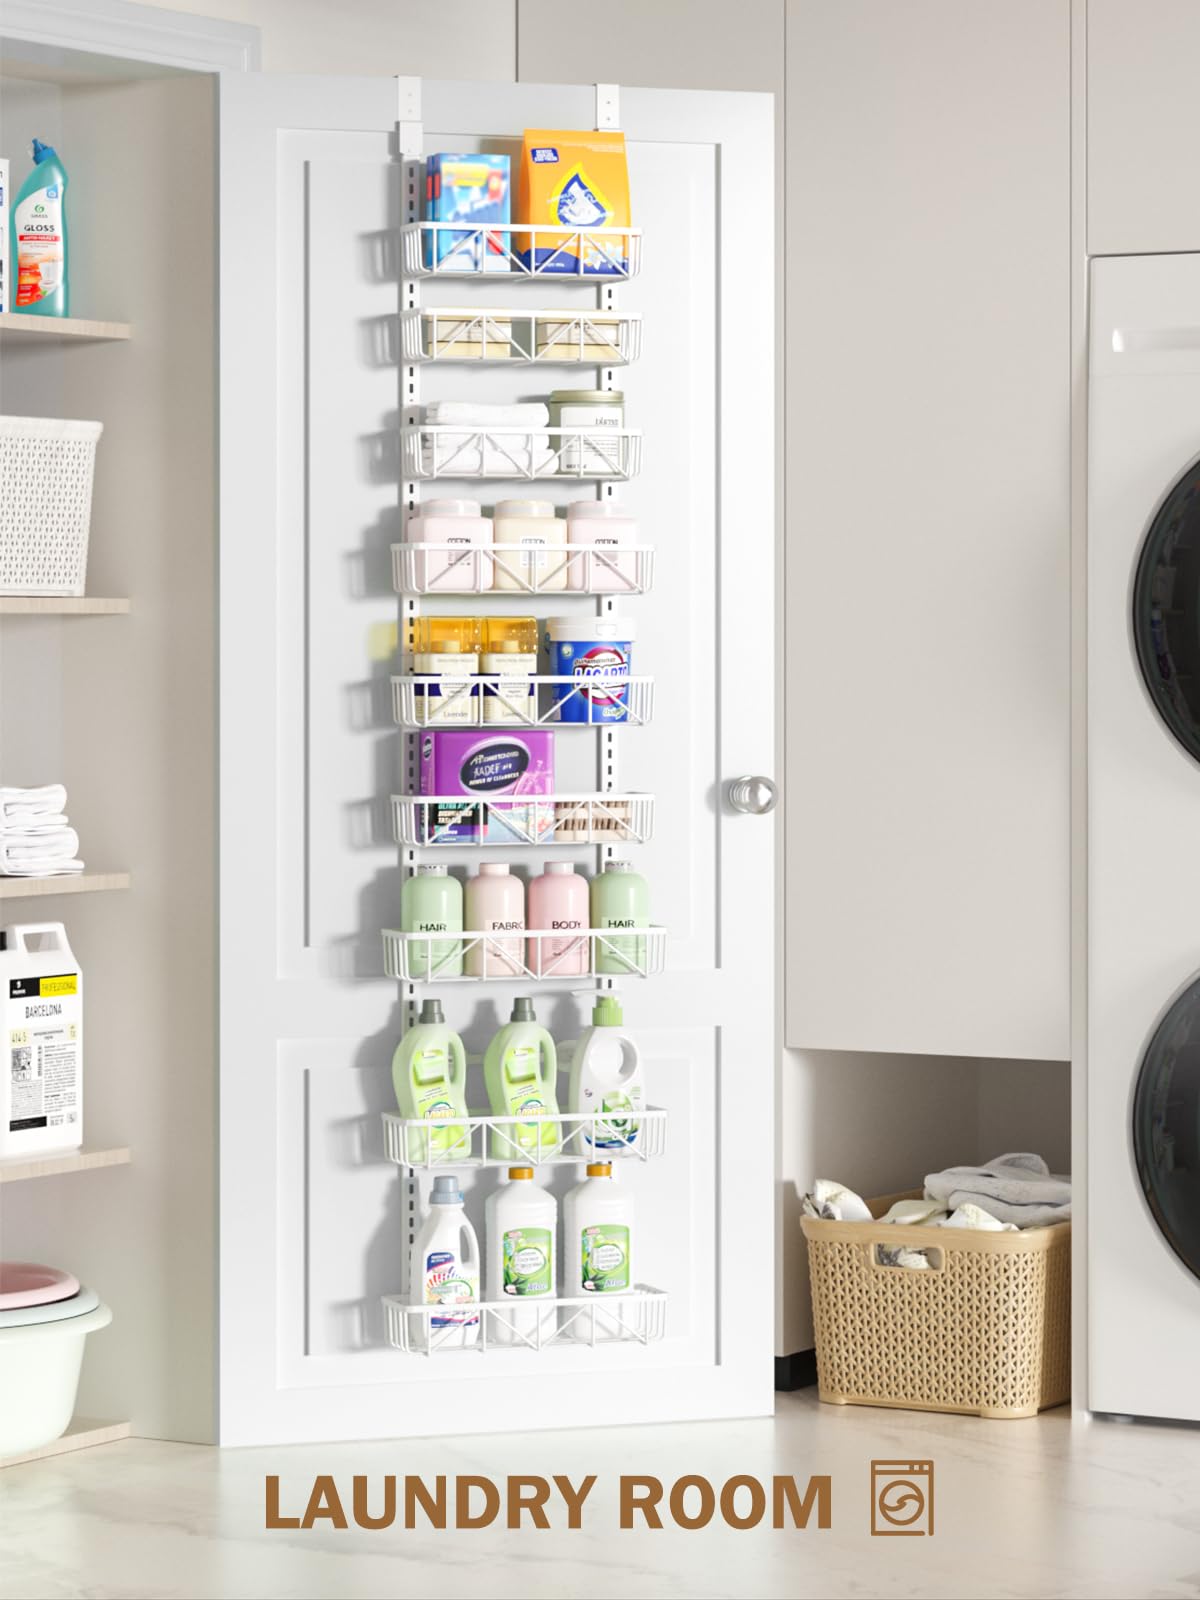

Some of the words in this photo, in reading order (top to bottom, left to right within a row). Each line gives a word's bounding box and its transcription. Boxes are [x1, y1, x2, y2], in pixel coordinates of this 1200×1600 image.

[24, 224, 55, 232] GLOSS
[419, 923, 447, 932] HAIR
[608, 919, 635, 928] HAIR
[25, 1003, 62, 1019] BARCELONA
